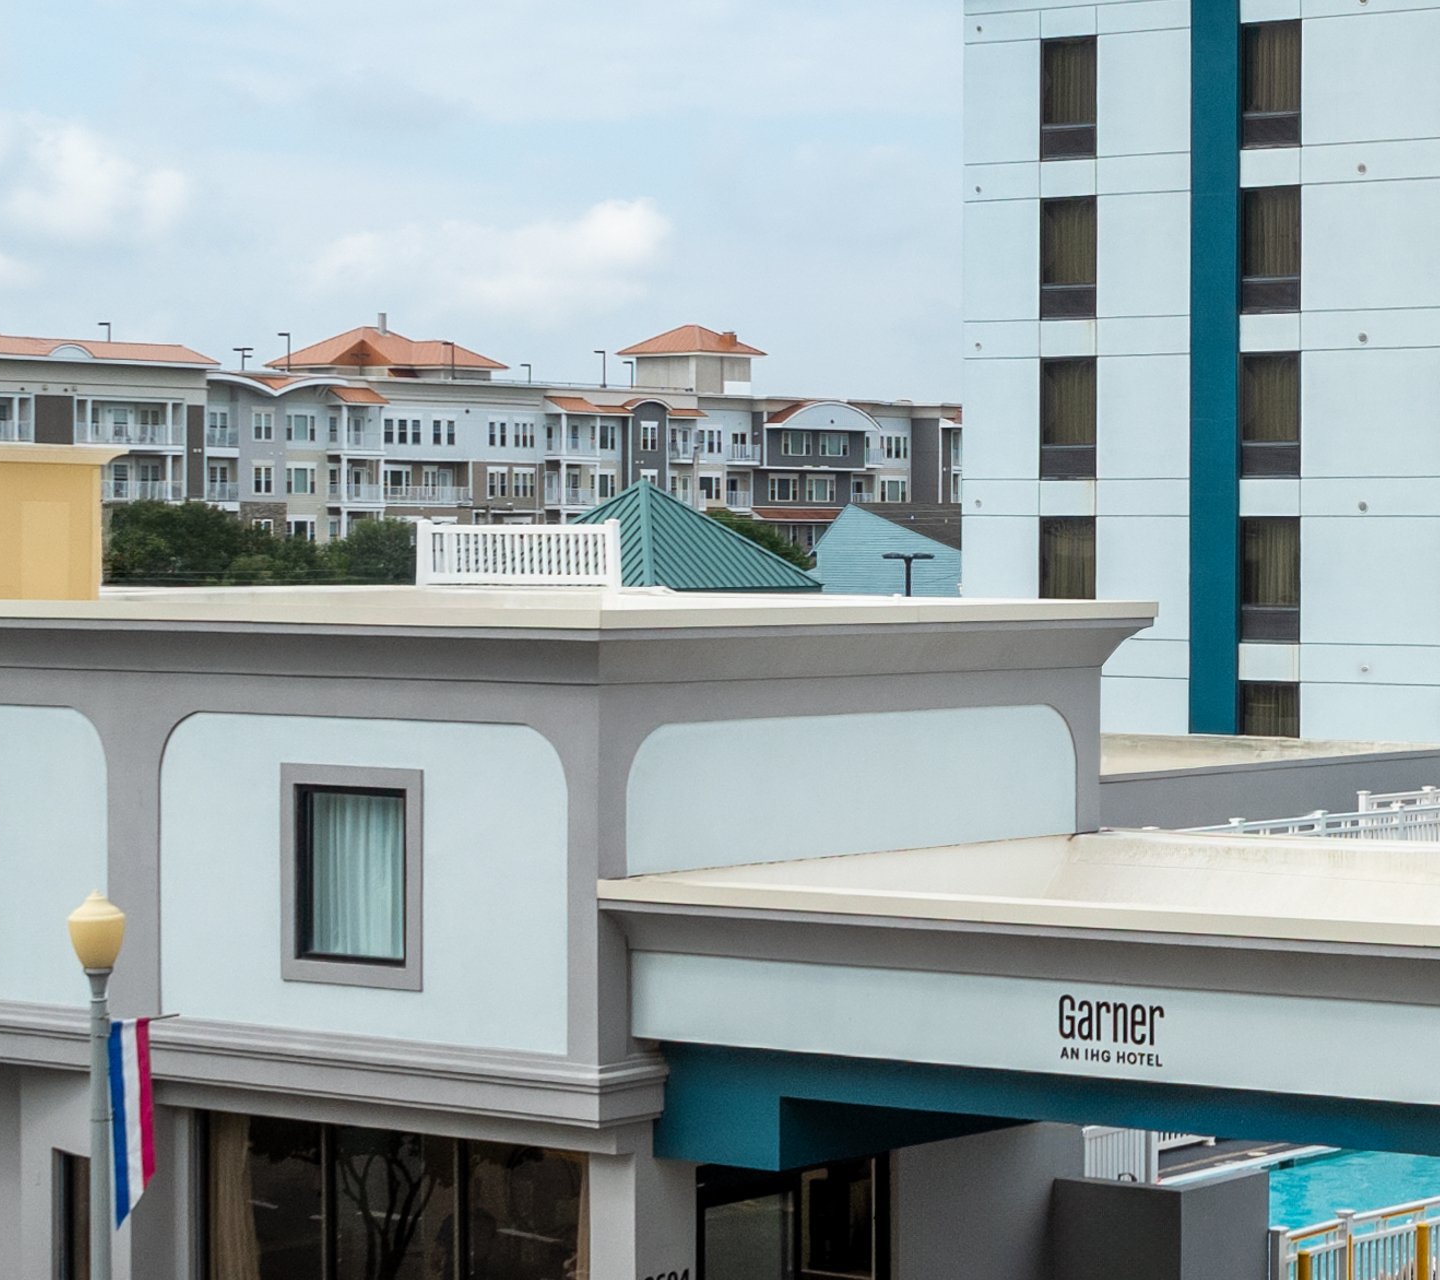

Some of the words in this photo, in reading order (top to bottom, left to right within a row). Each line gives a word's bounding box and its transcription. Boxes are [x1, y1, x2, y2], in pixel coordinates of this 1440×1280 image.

[1059, 994, 1165, 1046] Garner
[1060, 1046, 1079, 1060] AN
[1084, 1048, 1111, 1063] IHG
[1116, 1051, 1163, 1067] HOTEL
